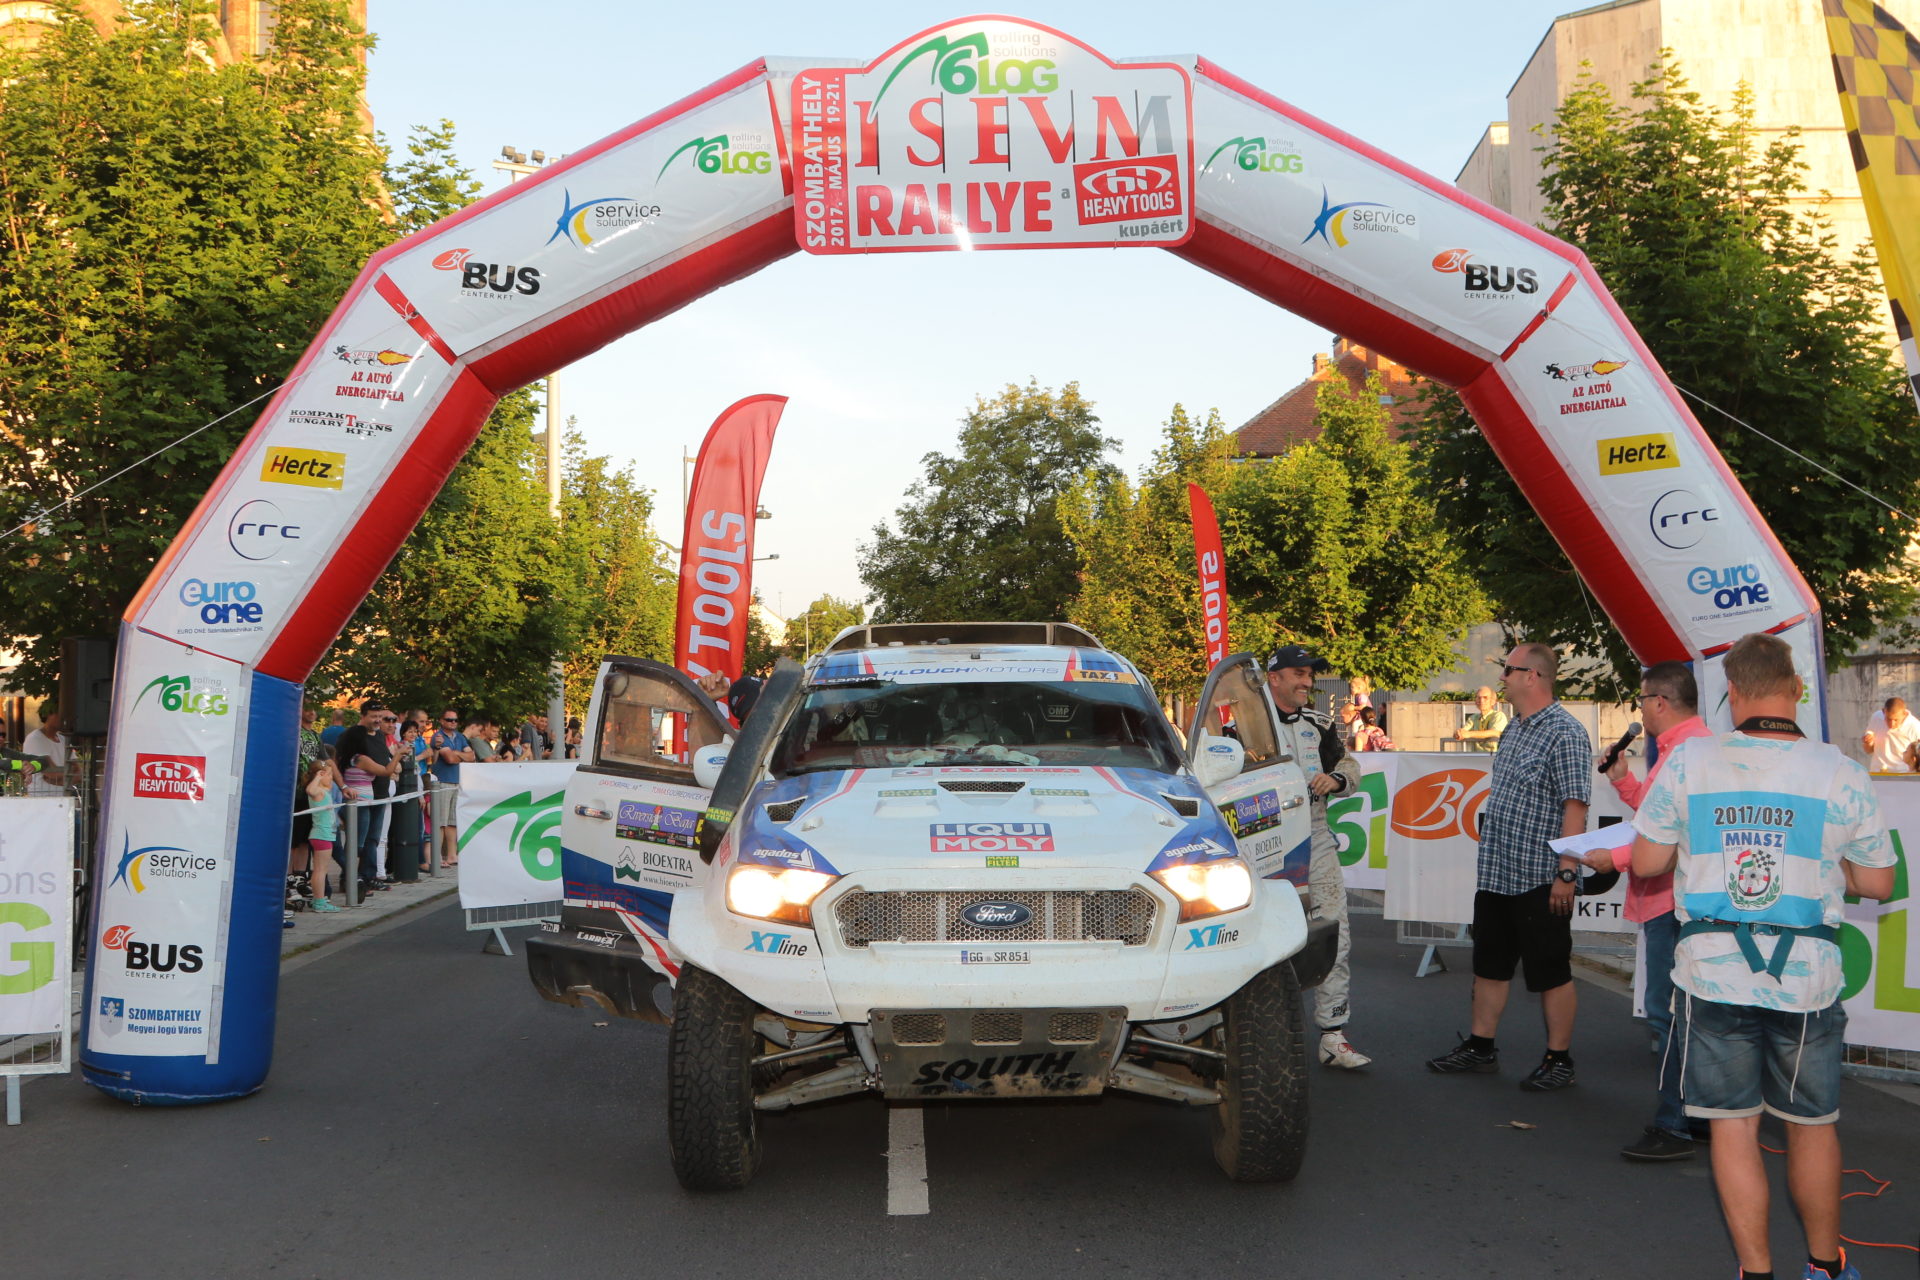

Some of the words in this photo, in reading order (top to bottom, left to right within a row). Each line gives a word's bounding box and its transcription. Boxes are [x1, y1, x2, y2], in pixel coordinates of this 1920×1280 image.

[993, 32, 1040, 46] rolling
[994, 46, 1057, 57] solutions
[826, 77, 841, 124] 19-21.
[802, 77, 827, 248] SZOMBATHELY
[824, 135, 843, 190] MÁJUS
[595, 203, 661, 218] service
[855, 180, 1054, 237] RALLYE
[1061, 188, 1071, 199] a
[1083, 195, 1130, 218] HEAVY
[1130, 191, 1175, 213] TOOLS
[596, 218, 641, 227] solution
[830, 202, 845, 248] 2017.
[1353, 207, 1416, 226] service
[1119, 219, 1184, 238] kupáért
[1353, 221, 1399, 233] solutions
[462, 262, 541, 295] BUS
[1465, 263, 1539, 294] BUS
[460, 290, 496, 300] CENTER
[497, 293, 513, 301] KFT
[351, 371, 364, 382] AZ
[367, 371, 392, 384] AUTÓ
[1573, 386, 1585, 398] AZ
[1588, 380, 1612, 396] AUTÓ
[1560, 396, 1627, 415] ENERGIAITALA
[288, 418, 344, 427] HUNGARY
[1608, 442, 1667, 465] Hertz
[270, 455, 333, 478] Hertz
[1660, 508, 1719, 527] rrc
[238, 523, 300, 539] rrc
[688, 509, 747, 655] TOOLS
[1687, 563, 1760, 595] euro
[179, 578, 256, 607] euro
[1714, 582, 1769, 609] one
[201, 602, 264, 625] one
[1048, 706, 1069, 715] OMP
[1759, 720, 1795, 731] Canon
[138, 778, 168, 793] HEAVY
[168, 780, 199, 794] TOOLS
[706, 812, 732, 823] FILTER
[707, 807, 733, 817] MANN
[1714, 805, 1795, 827] 2017/032
[936, 823, 1046, 837] LIQUI
[937, 837, 1051, 851] MOLY
[1255, 835, 1282, 856] BIOEXTRA
[1725, 832, 1784, 848] MNASZ
[753, 848, 800, 859] agados
[1164, 842, 1209, 859] agados
[149, 854, 217, 871] service
[643, 851, 693, 872] BIOEXTRA
[150, 867, 198, 879] solutions
[975, 904, 1017, 922] Ford
[1578, 901, 1622, 918] KFT
[126, 942, 204, 973] BUS
[970, 952, 983, 962] GG
[994, 952, 1007, 962] SR
[1008, 952, 1029, 962] 851
[125, 971, 157, 979] CENTER
[128, 1008, 202, 1022] SZOMBATHELY
[127, 1024, 156, 1034] Megyei
[178, 1024, 202, 1035] Város
[911, 1051, 1078, 1086] SOUTH
